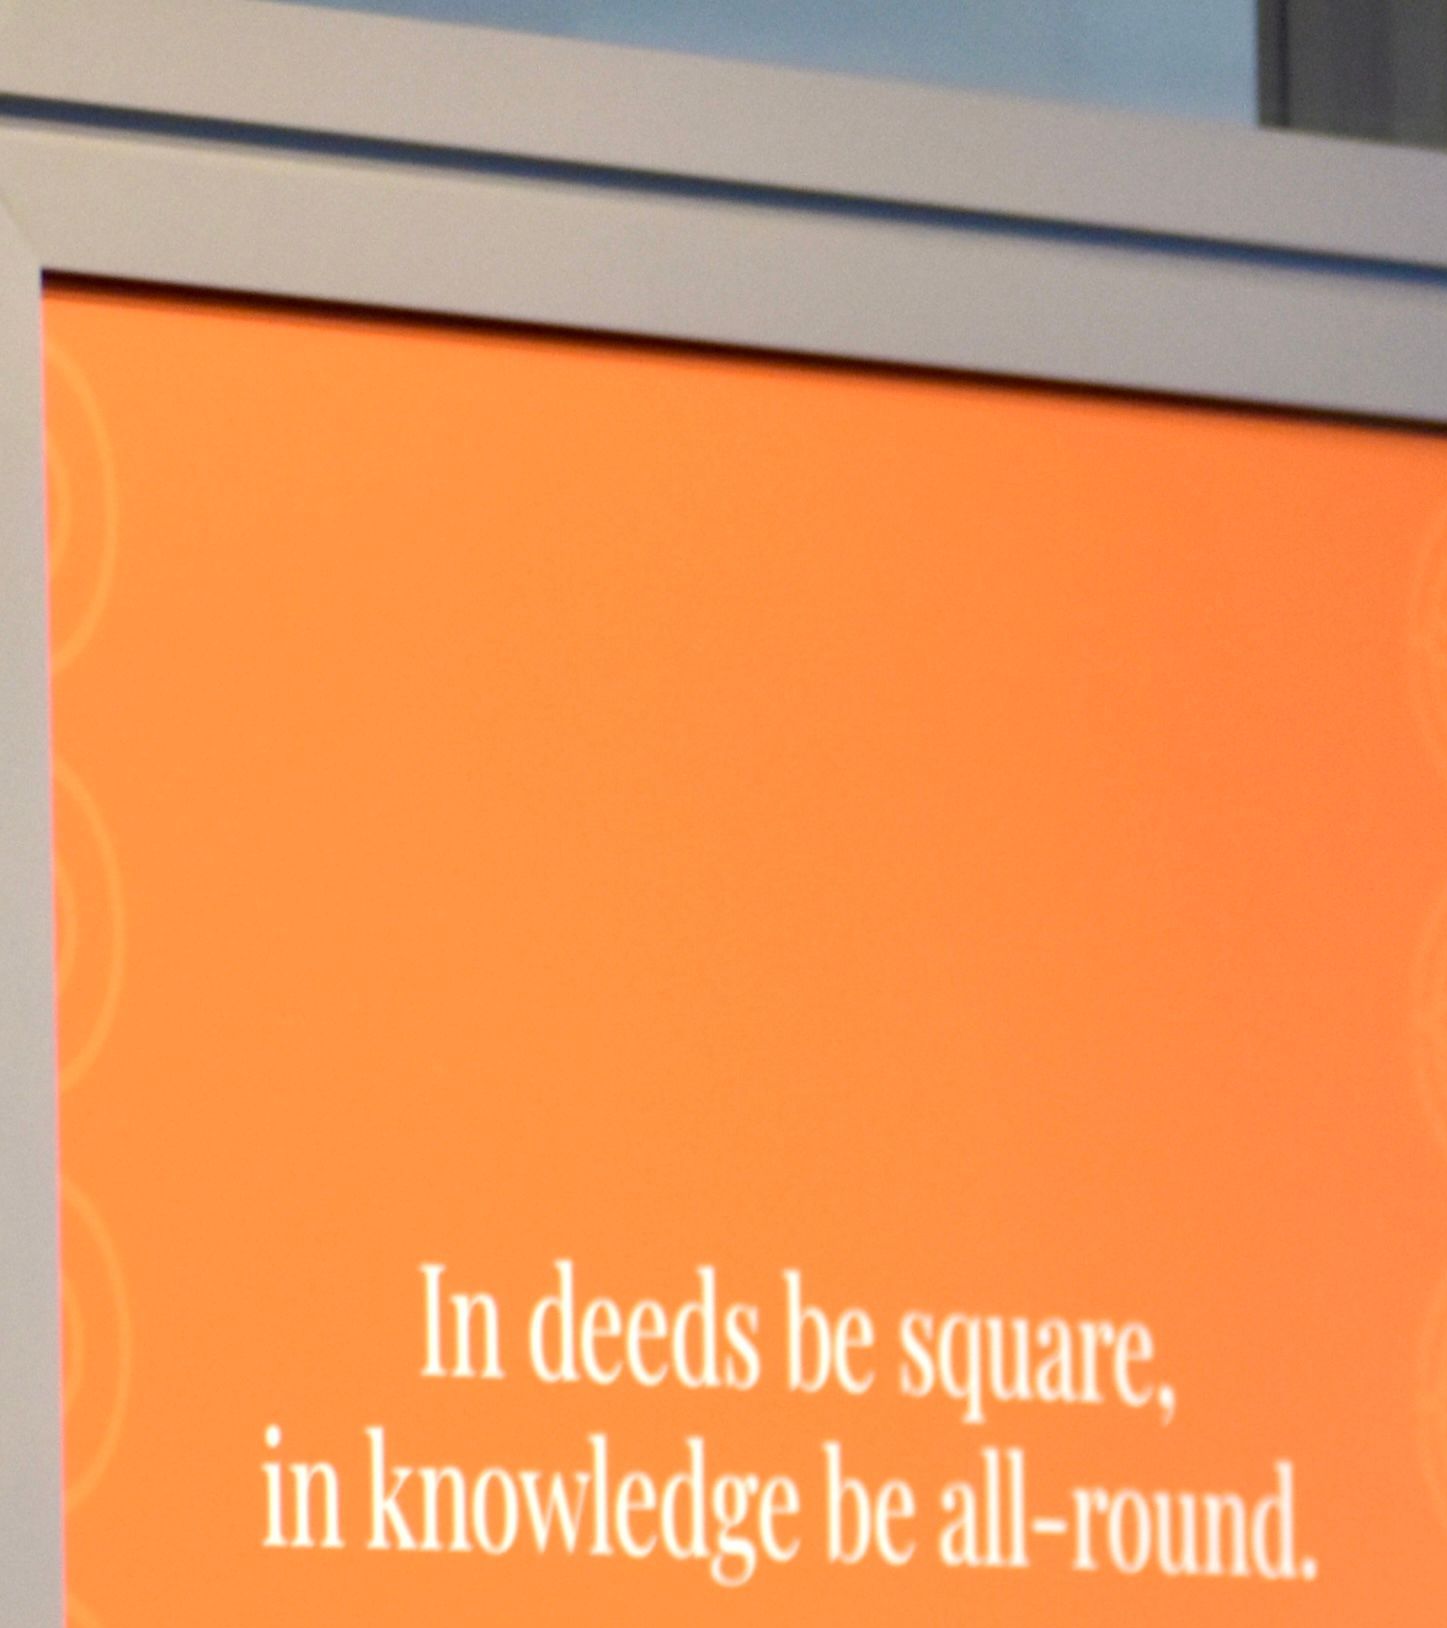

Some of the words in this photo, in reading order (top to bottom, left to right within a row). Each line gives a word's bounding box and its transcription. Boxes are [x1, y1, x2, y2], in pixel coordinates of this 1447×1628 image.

[419, 1262, 506, 1380] In
[529, 1258, 760, 1390] deeds
[783, 1268, 875, 1396] be
[899, 1302, 1177, 1425] square,
[262, 1424, 343, 1548] in
[365, 1425, 800, 1588] knowledge
[824, 1440, 916, 1566] be
[938, 1447, 1318, 1581] all-round.
